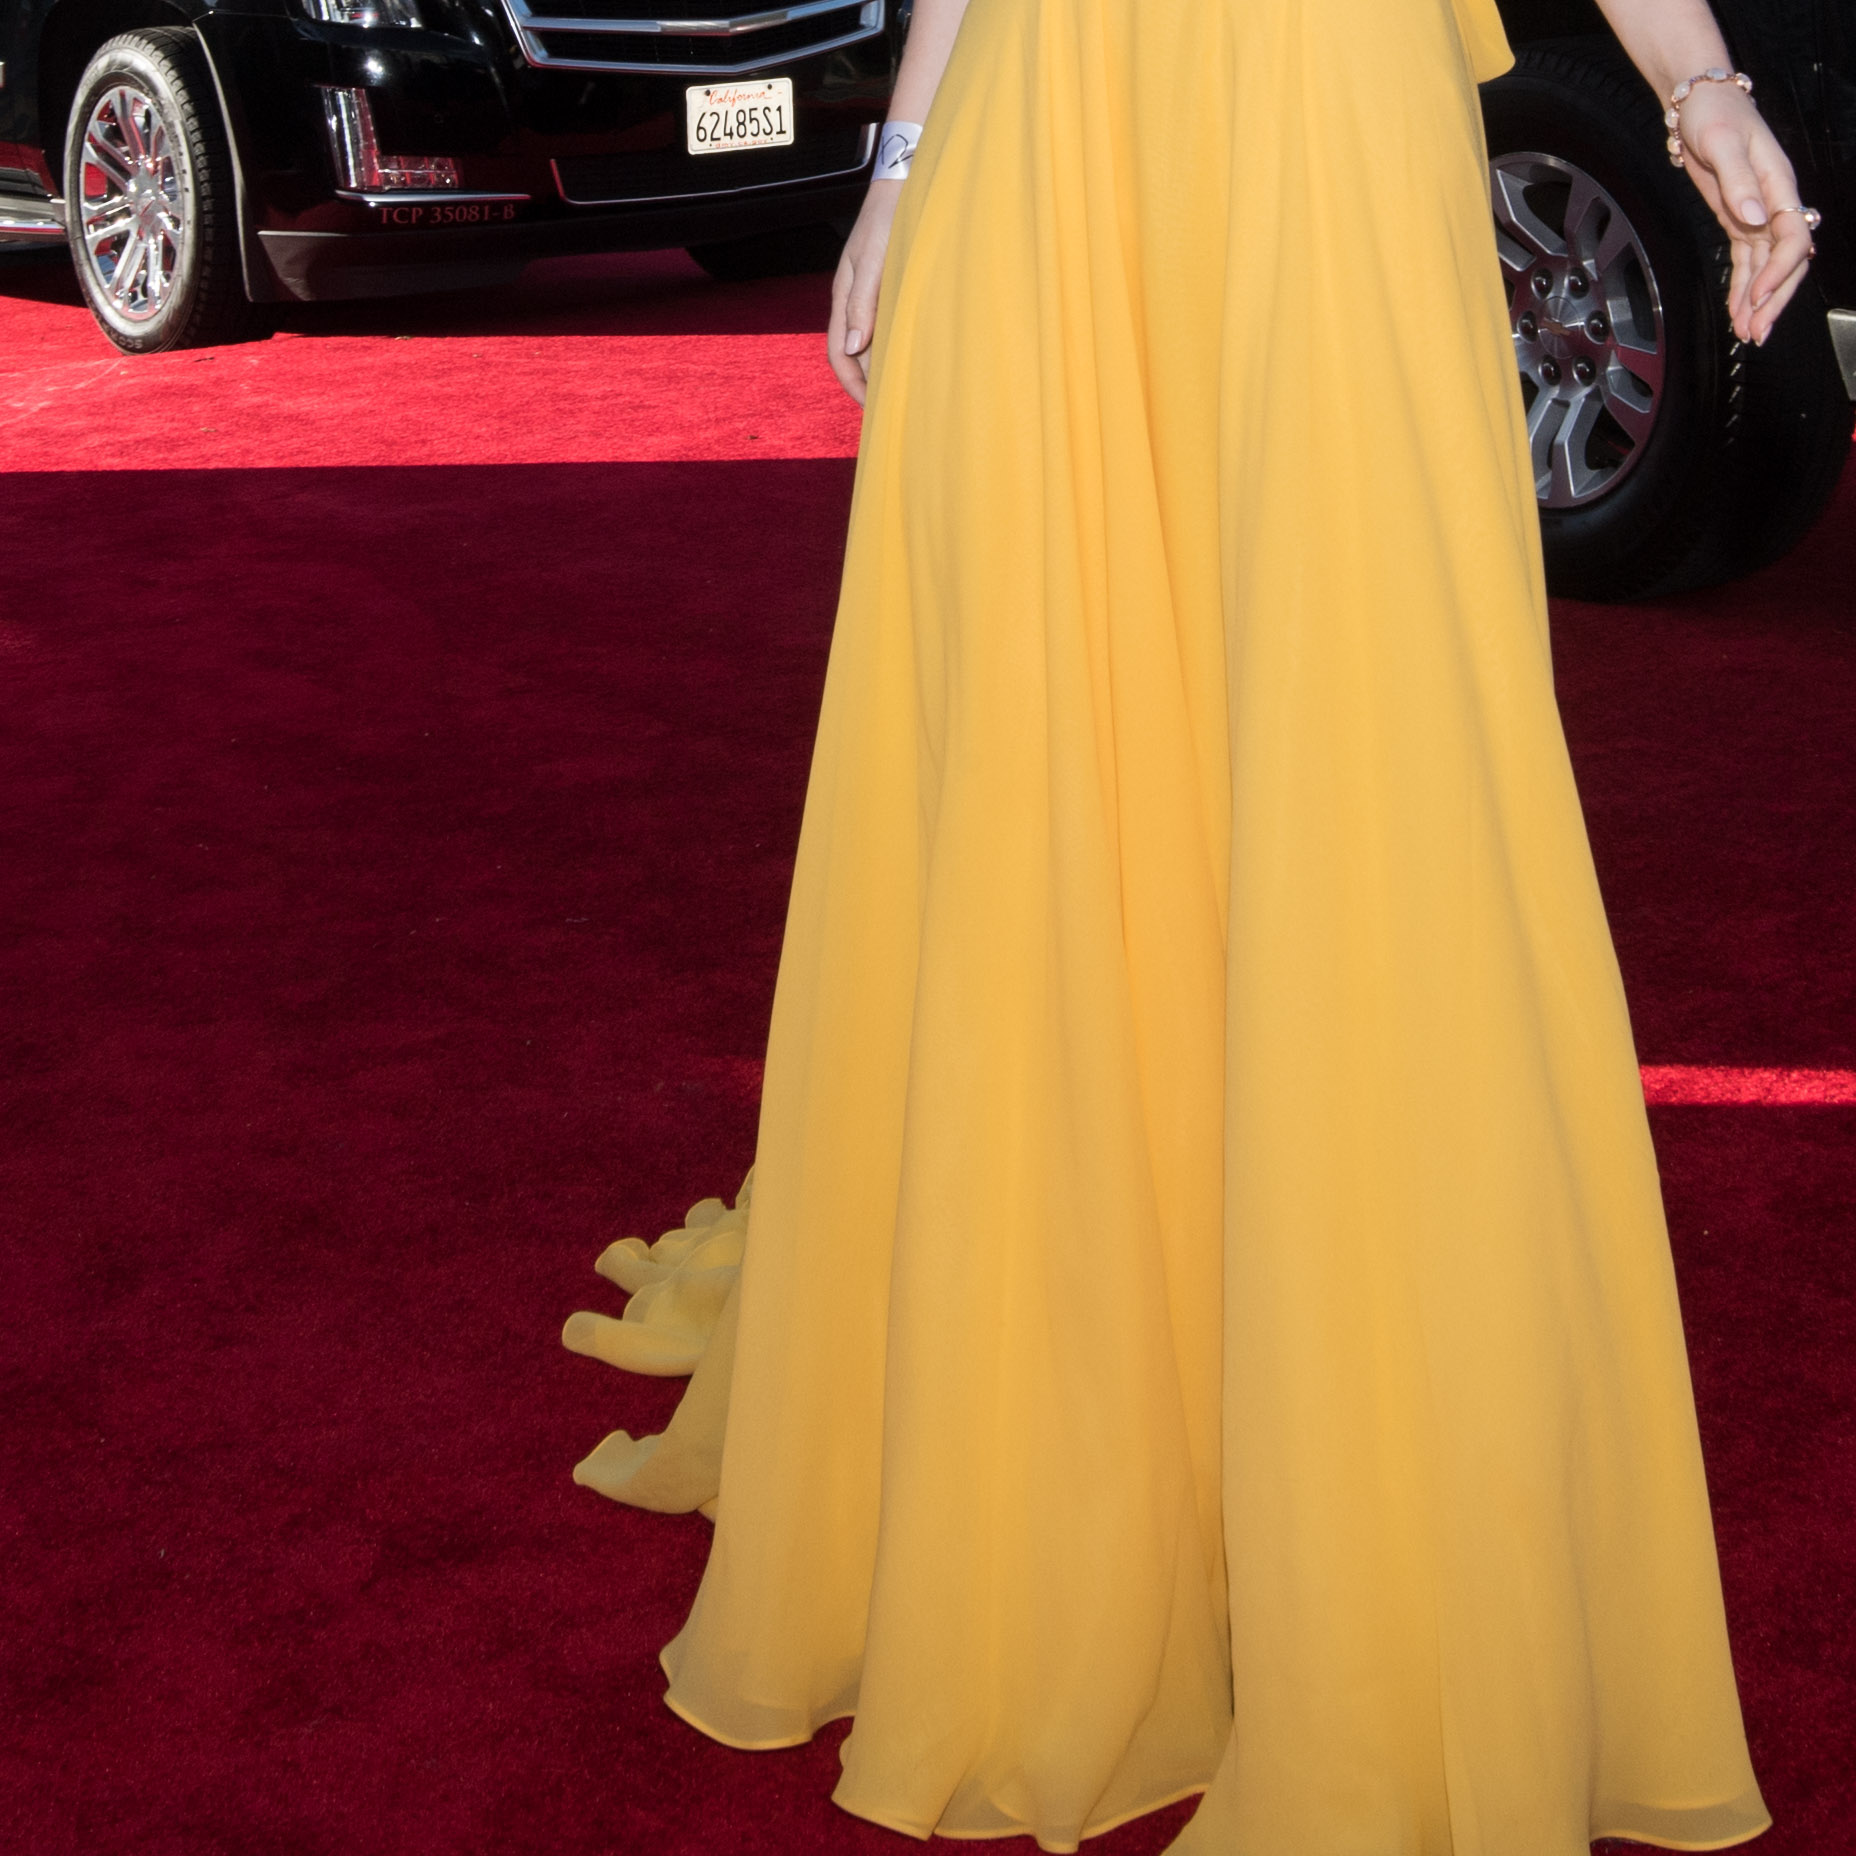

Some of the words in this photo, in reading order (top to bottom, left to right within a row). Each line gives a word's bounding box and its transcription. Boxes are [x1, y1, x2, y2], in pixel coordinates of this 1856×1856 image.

[709, 88, 771, 108] California
[696, 105, 787, 143] 62485S1
[379, 207, 423, 225] TCP
[430, 204, 515, 224] 35081-B
